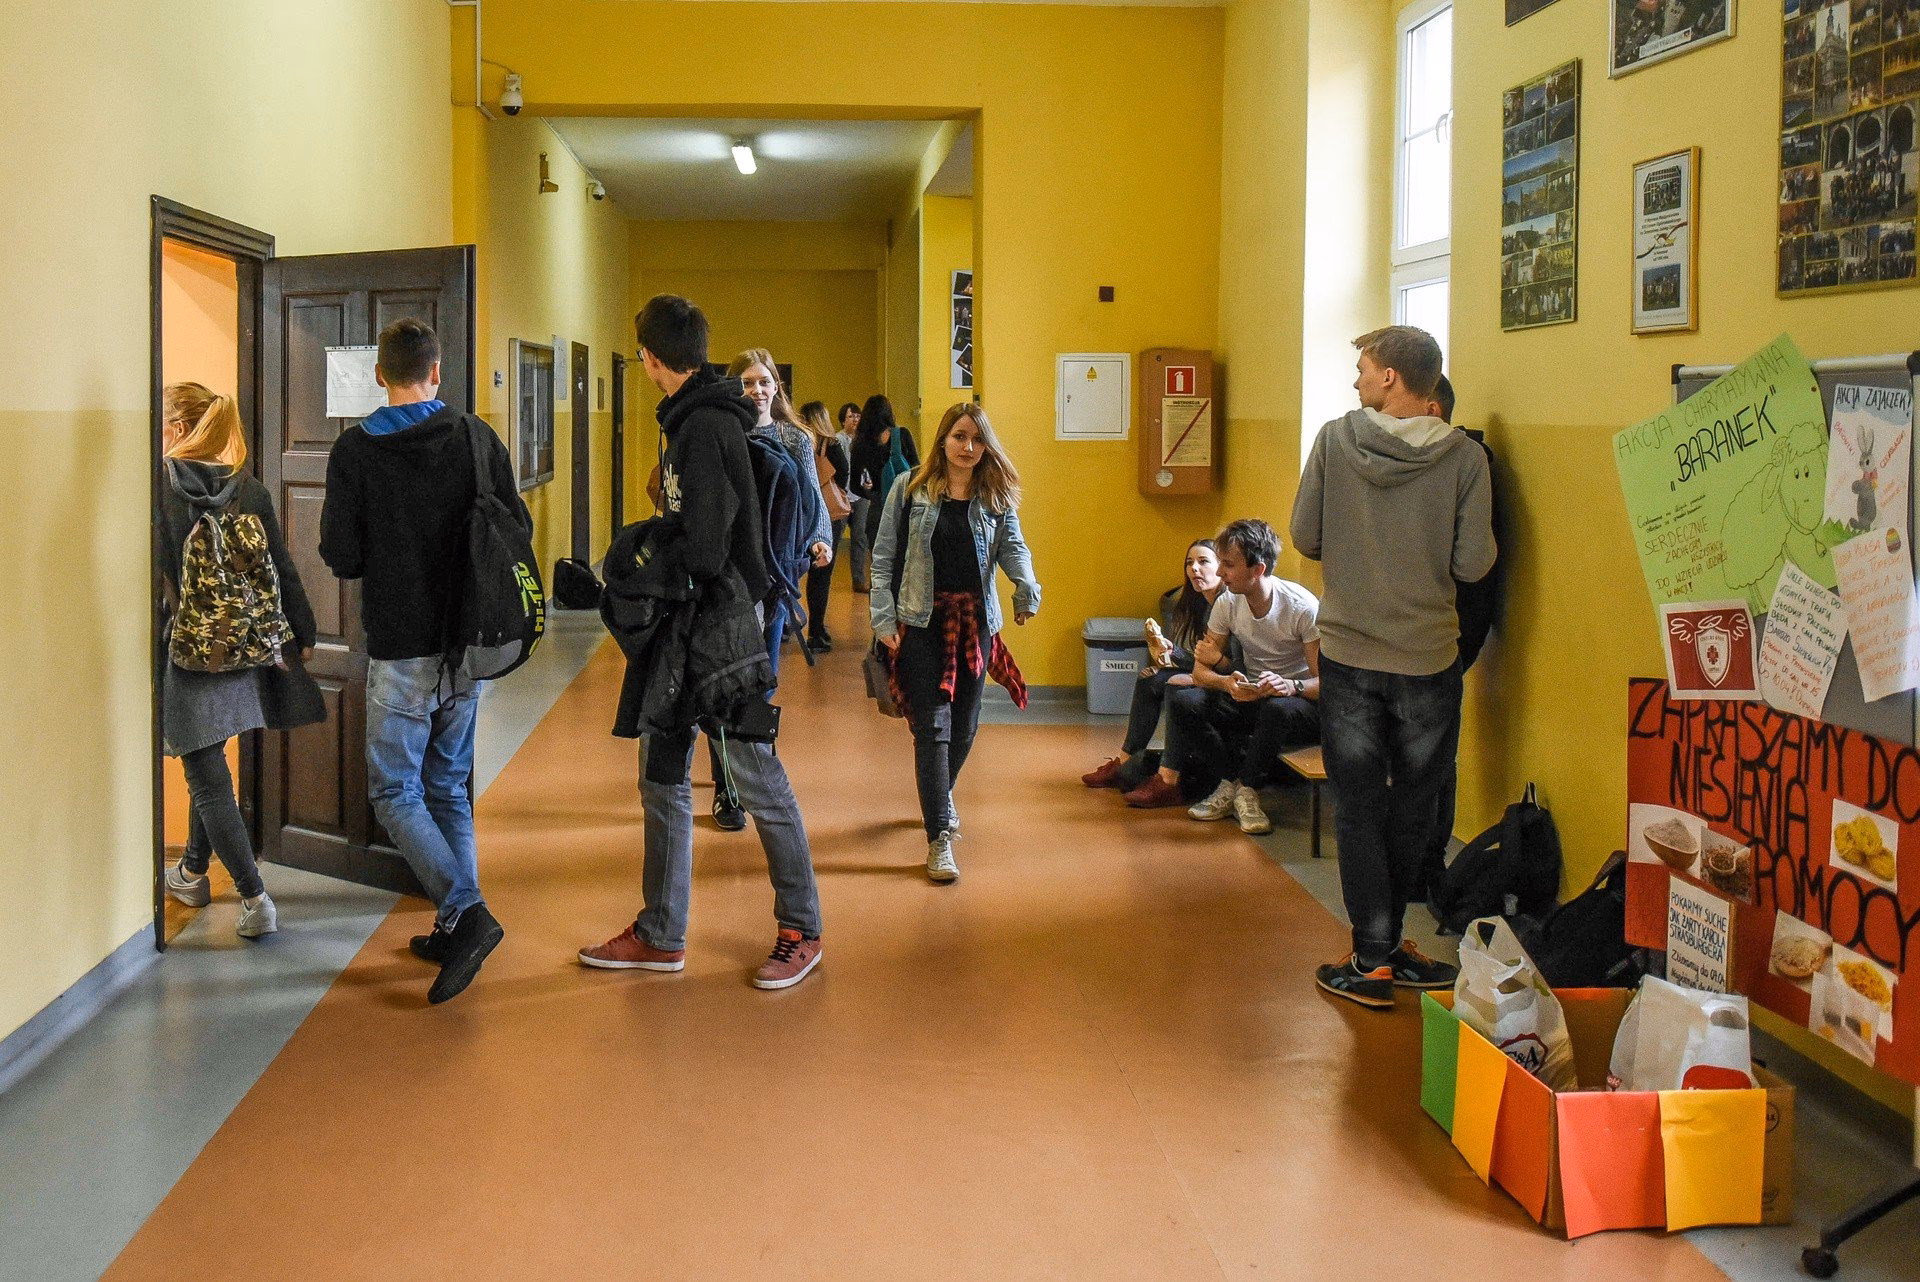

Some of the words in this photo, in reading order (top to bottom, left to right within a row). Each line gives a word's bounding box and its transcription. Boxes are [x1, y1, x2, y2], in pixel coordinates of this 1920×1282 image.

[1835, 386, 1861, 409] AKCJA
[1618, 415, 1675, 459] AKCJA
[1645, 515, 1709, 556] SERDECZNIE
[1655, 577, 1670, 590] DO
[1105, 661, 1134, 670] ŚMIECI
[1629, 677, 1849, 797] ZAPRASZAMY
[1865, 735, 1920, 823] DO
[1671, 891, 1703, 918] POKARMY
[1704, 908, 1727, 933] SUCHE
[1669, 923, 1724, 964] STRASBURGERA
